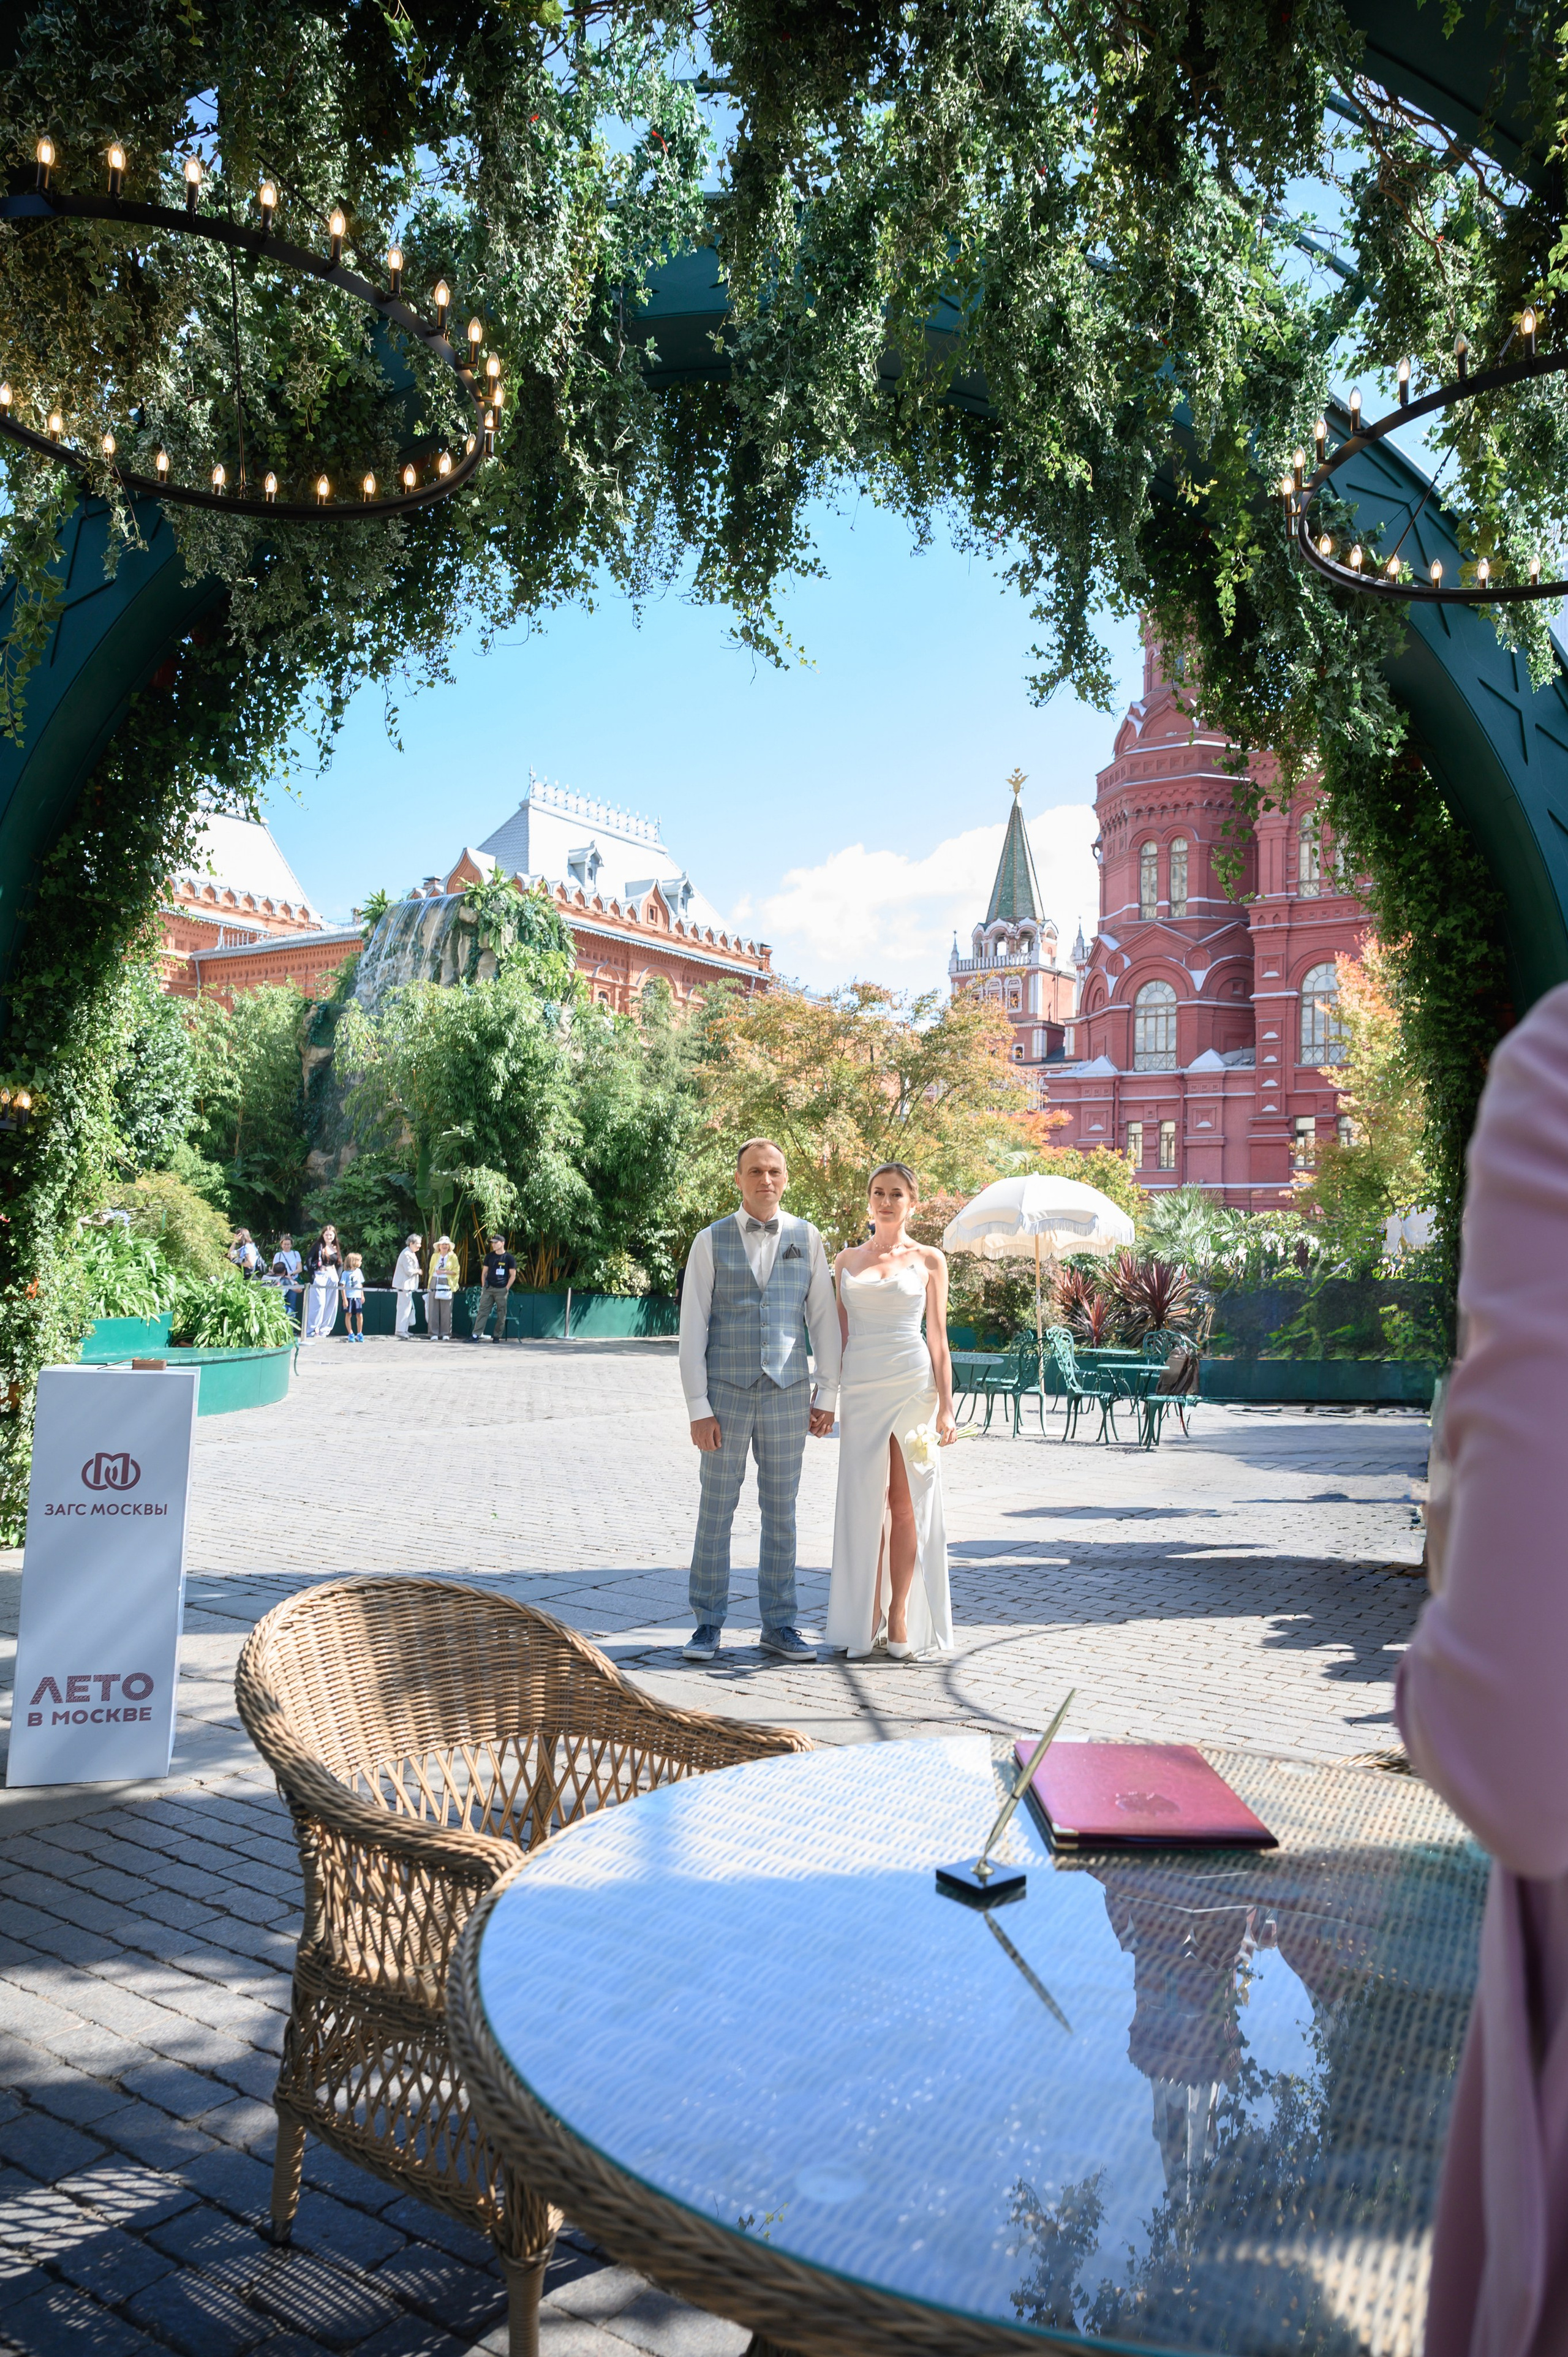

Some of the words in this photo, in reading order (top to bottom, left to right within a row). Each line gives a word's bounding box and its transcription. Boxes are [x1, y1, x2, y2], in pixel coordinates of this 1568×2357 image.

[44, 1504, 87, 1516] ЗАГС
[90, 1504, 168, 1516] МОСКВЫ
[29, 1672, 154, 1705] ЛЕТО
[28, 1712, 43, 1727] В
[51, 1706, 152, 1725] МОСКВЕ
